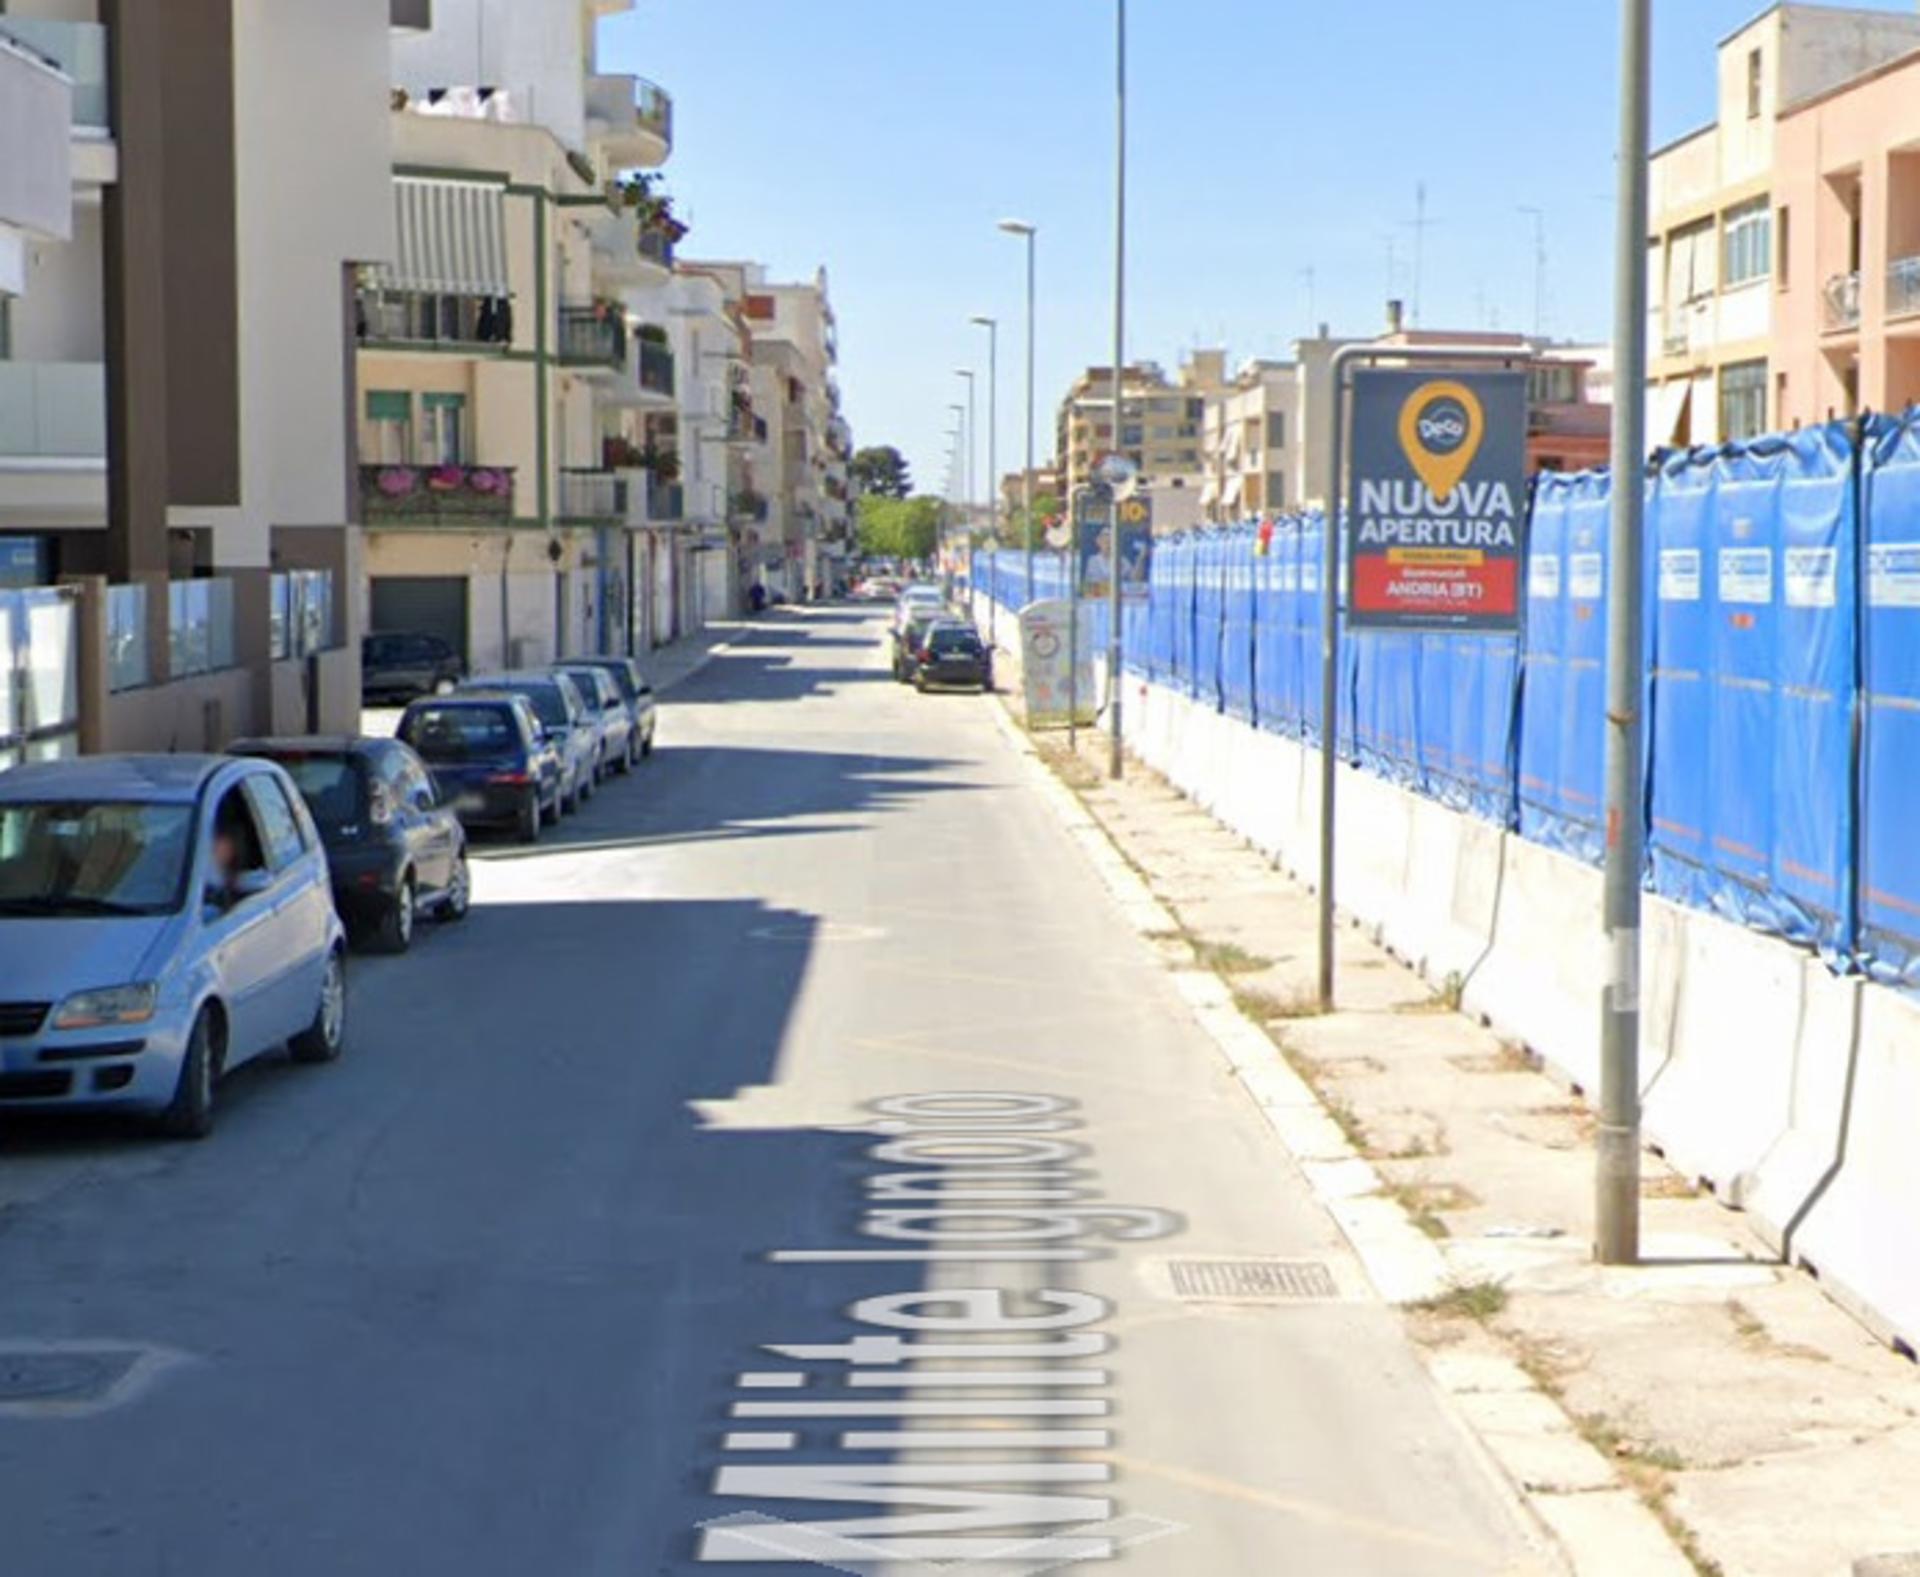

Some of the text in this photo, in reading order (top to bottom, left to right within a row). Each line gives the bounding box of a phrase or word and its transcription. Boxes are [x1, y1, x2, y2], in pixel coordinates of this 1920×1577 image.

[1360, 480, 1515, 517] NUOVA
[1358, 518, 1515, 546] APERTURA
[1386, 581, 1448, 598] ANDRIA
